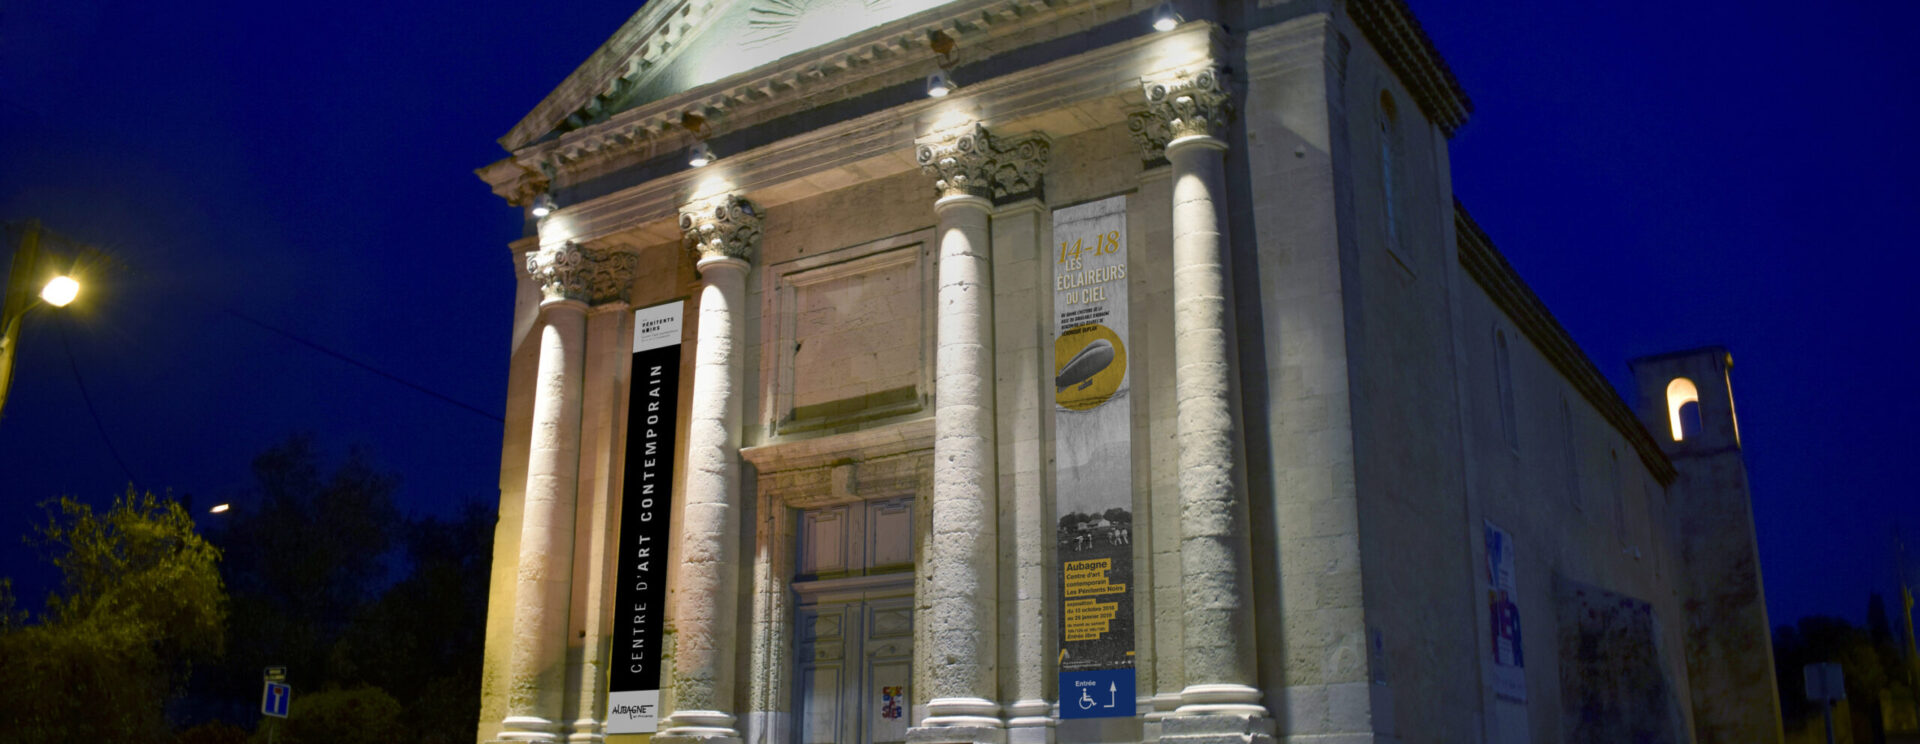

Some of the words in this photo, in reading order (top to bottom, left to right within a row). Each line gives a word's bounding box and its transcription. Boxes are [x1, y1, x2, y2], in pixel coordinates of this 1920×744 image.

[1057, 230, 1120, 264] 14-18
[1066, 257, 1082, 272] LES
[1057, 263, 1126, 291] ÉCLAIREURS
[1066, 291, 1079, 305] DU
[1082, 286, 1106, 304] CIEL
[640, 365, 662, 522] CONTEMPORAIN
[636, 535, 651, 591] D'ART
[1066, 561, 1107, 571] Aubagne
[1066, 580, 1107, 588] contemporain
[630, 602, 647, 674] CENTRE
[612, 704, 654, 720] AUBAGNE
